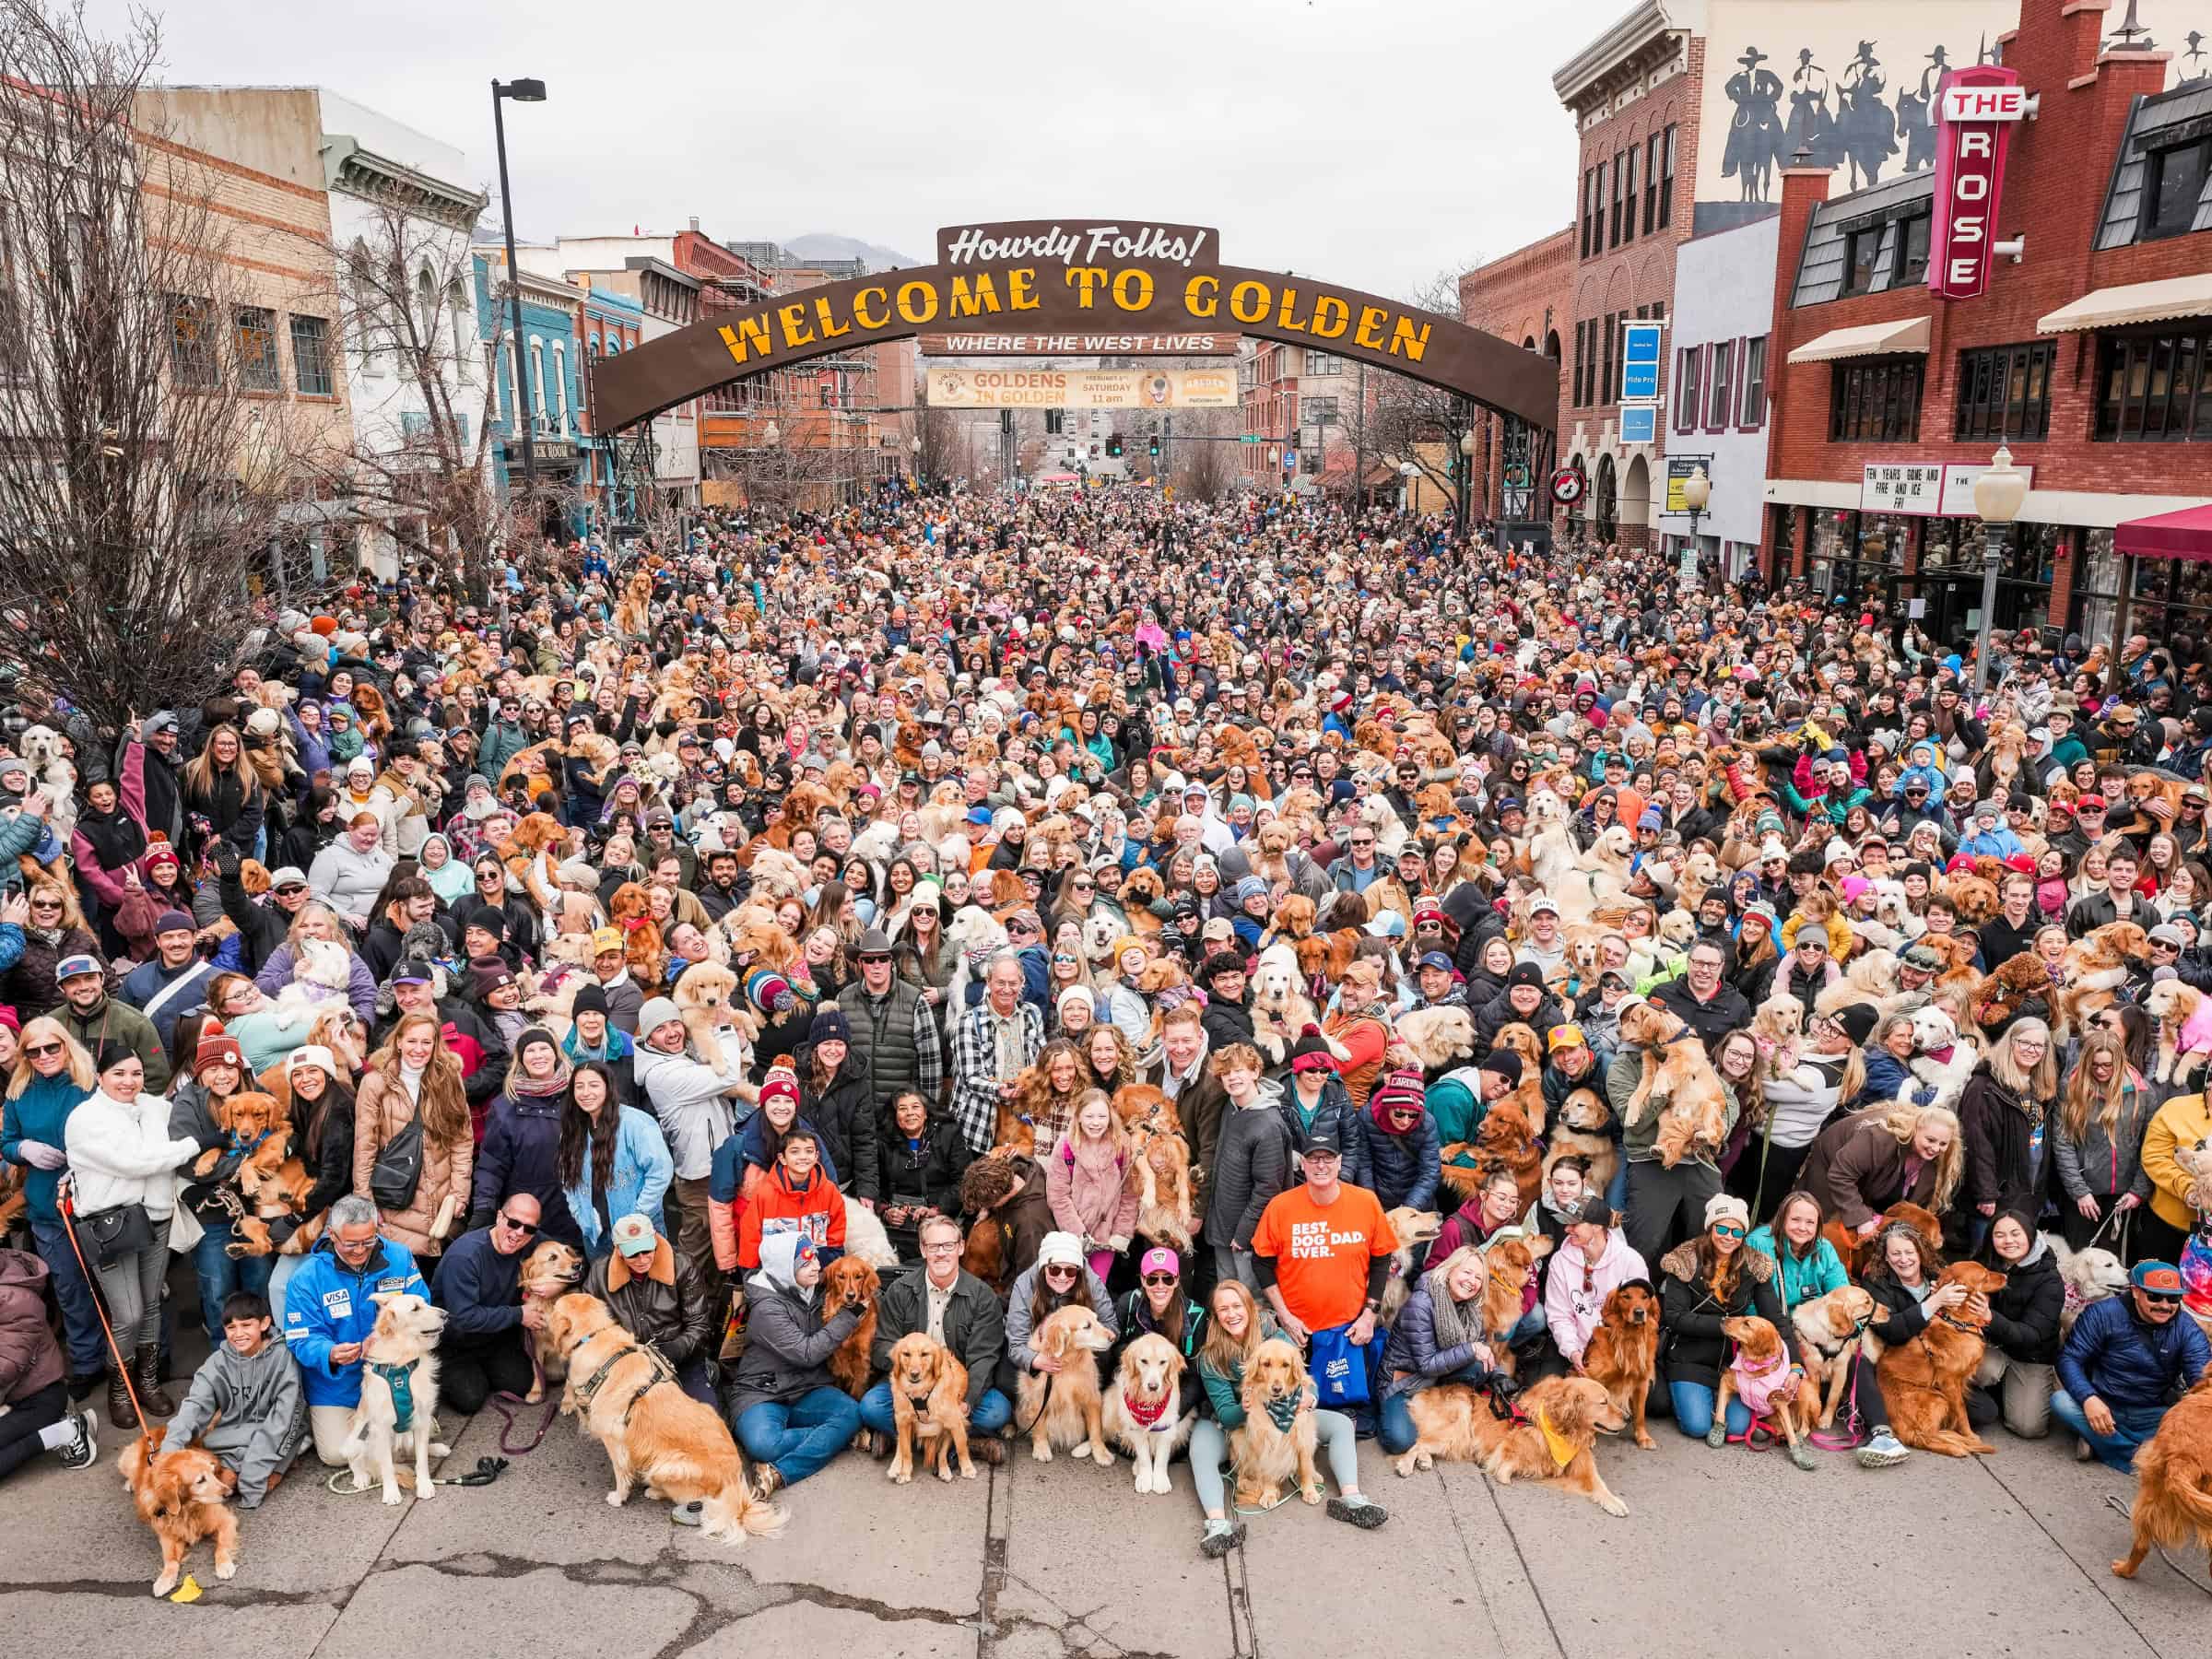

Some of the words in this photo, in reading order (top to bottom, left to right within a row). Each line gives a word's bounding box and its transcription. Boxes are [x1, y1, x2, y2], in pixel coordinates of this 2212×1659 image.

[1953, 94, 2021, 115] THE
[1949, 132, 1991, 284] ROSE
[948, 226, 1081, 265] Howdy
[1086, 226, 1206, 266] Folks!
[717, 268, 1041, 365] WELCOME
[1065, 267, 1154, 312] TO
[1183, 276, 1432, 362] GOLDEN
[947, 335, 1027, 350] WHERE
[1034, 335, 1077, 350] THE
[1084, 335, 1147, 350] WEST
[1153, 335, 1214, 350] LIVES
[973, 373, 1066, 388] GOLDENS
[1083, 383, 1132, 392] SATURDAY
[975, 390, 994, 404] IN
[1001, 390, 1066, 404] GOLDEN
[1866, 468, 1877, 480] TEN
[1882, 468, 1900, 480] YEARS
[1926, 469, 1938, 481] AND
[1876, 482, 1888, 494] FIRE
[1895, 483, 1907, 495] AND
[1911, 484, 1921, 496] ICE
[1893, 497, 1904, 509] FRI
[1291, 1220, 1330, 1235] BEST.
[1291, 1235, 1325, 1247] DOG
[1331, 1232, 1366, 1244] DAD.
[1291, 1247, 1335, 1259] EVER.
[324, 1290, 348, 1303] VISA
